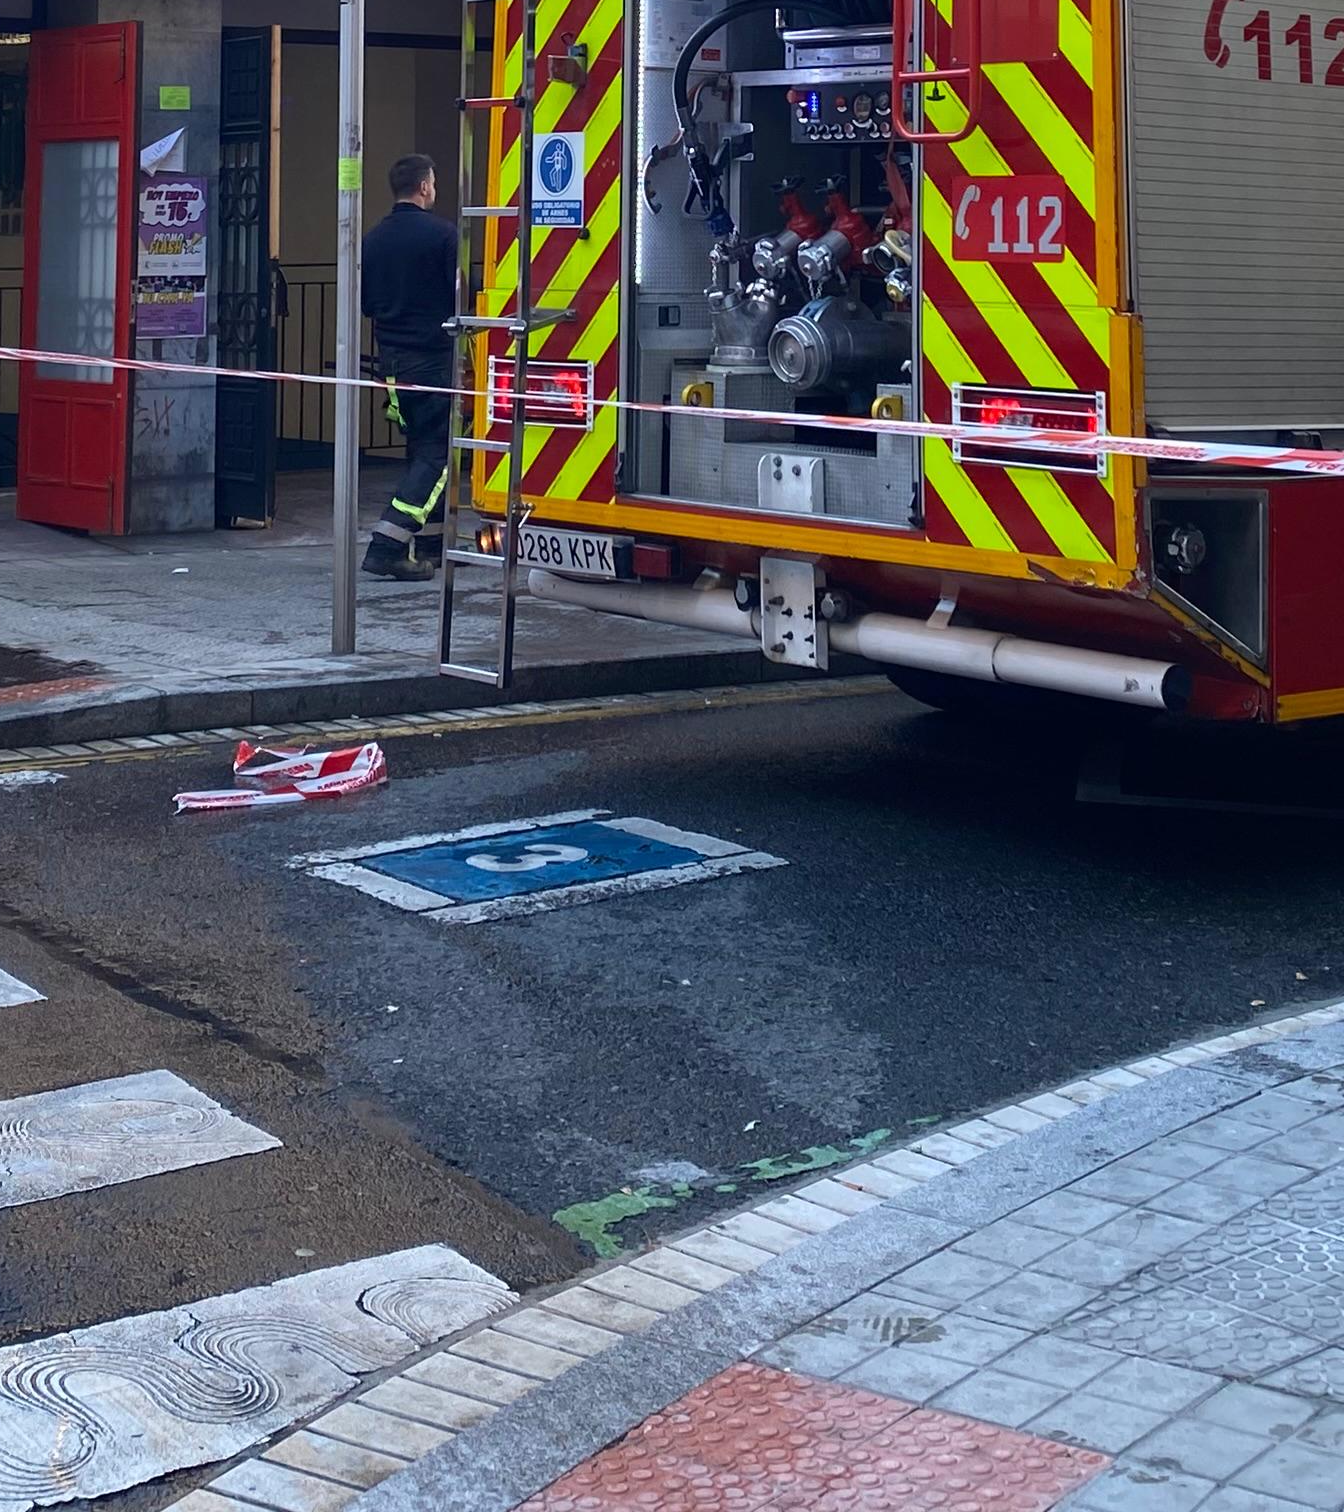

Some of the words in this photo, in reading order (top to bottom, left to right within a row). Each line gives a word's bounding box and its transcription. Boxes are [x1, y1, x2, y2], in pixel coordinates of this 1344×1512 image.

[988, 196, 1062, 254] 112
[568, 537, 612, 571] KPK
[465, 842, 588, 874] 3
